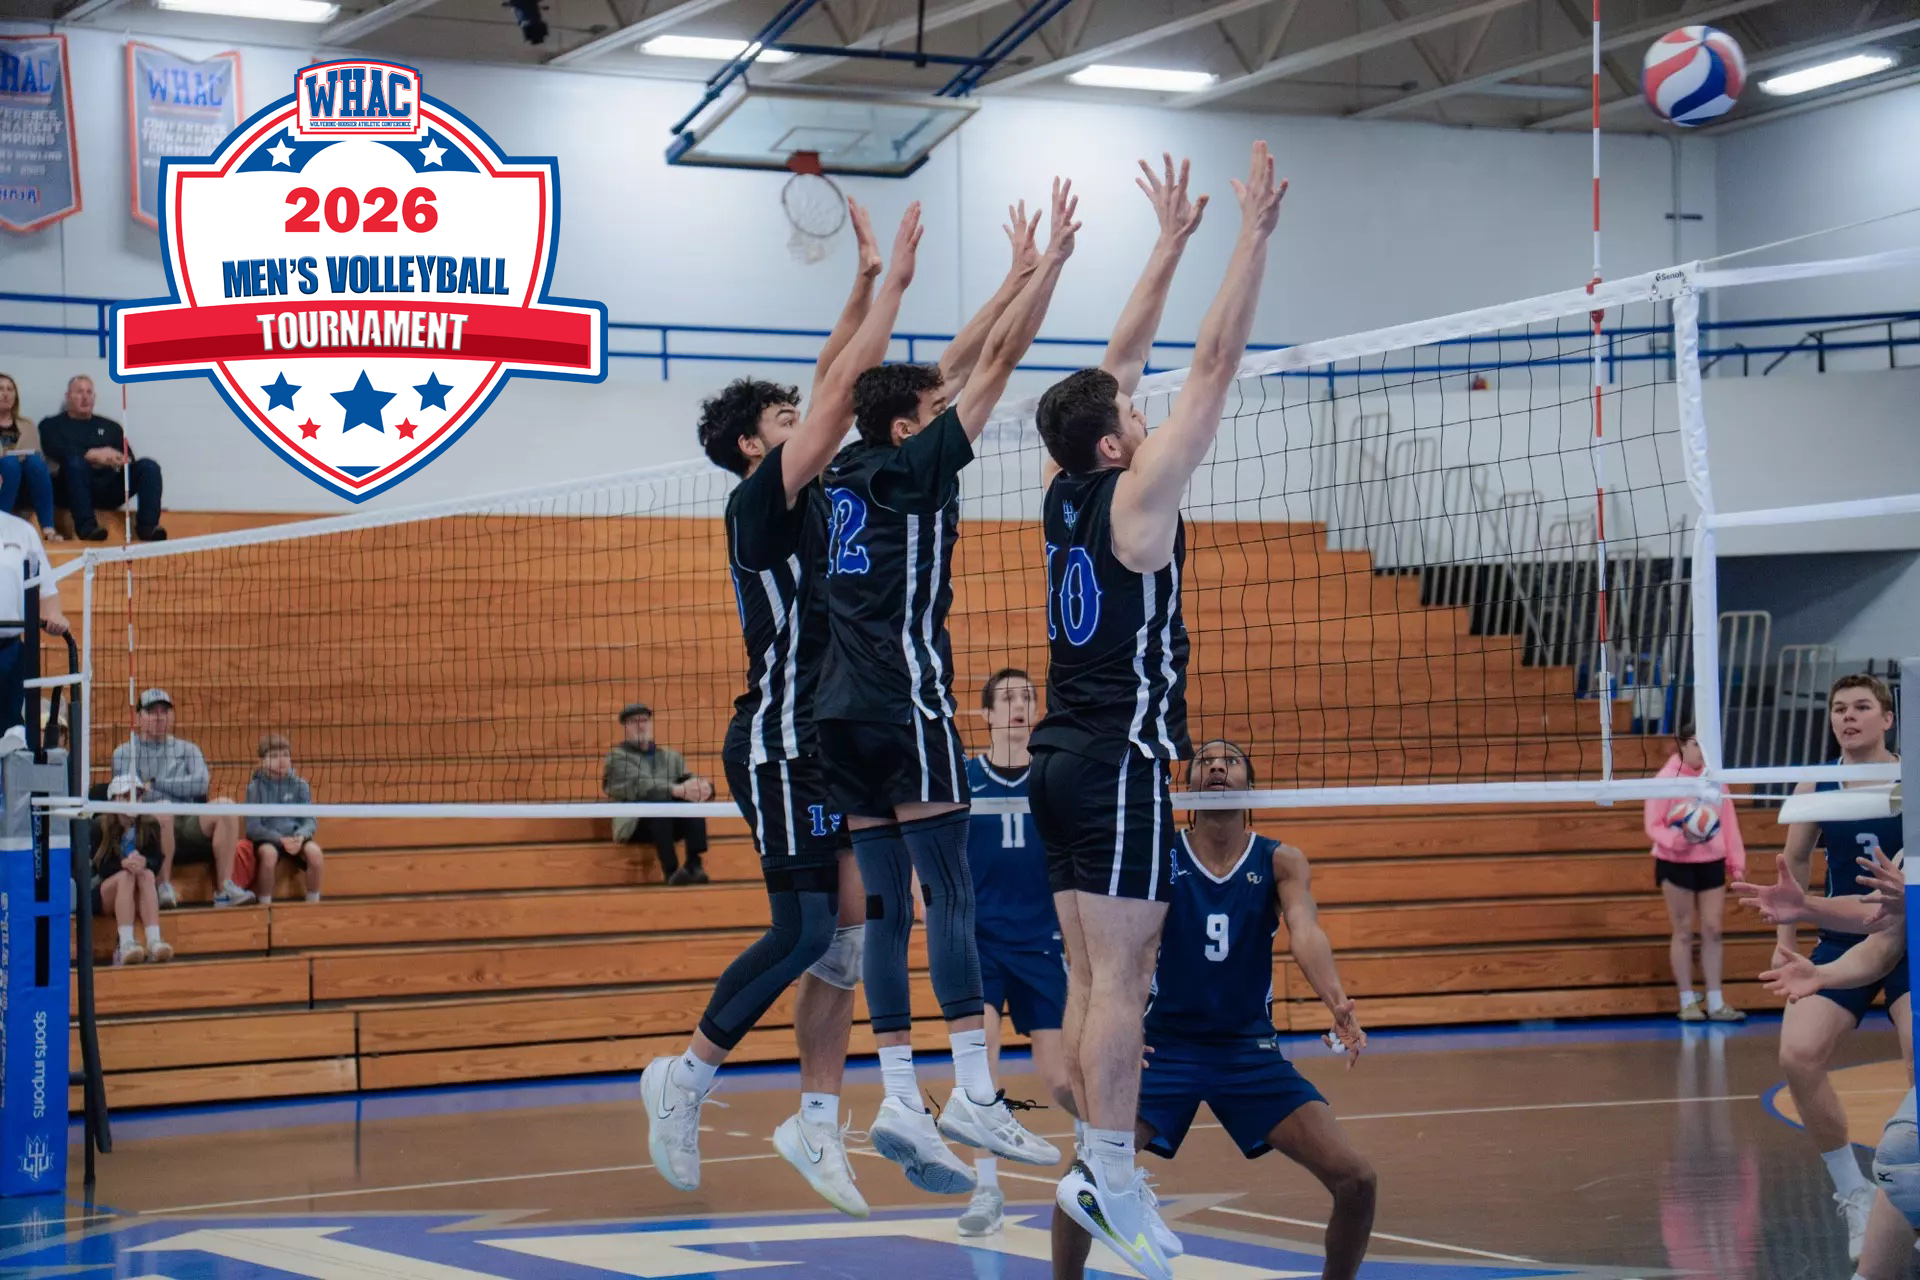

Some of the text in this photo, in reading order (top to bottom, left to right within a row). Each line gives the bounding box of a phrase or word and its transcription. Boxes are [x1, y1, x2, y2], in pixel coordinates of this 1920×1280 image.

[147, 67, 223, 106] WHAC
[1661, 270, 1685, 281] Senoh
[1001, 813, 1026, 849] 11
[1204, 913, 1230, 962] 9
[31, 1010, 47, 1119] sports imports
